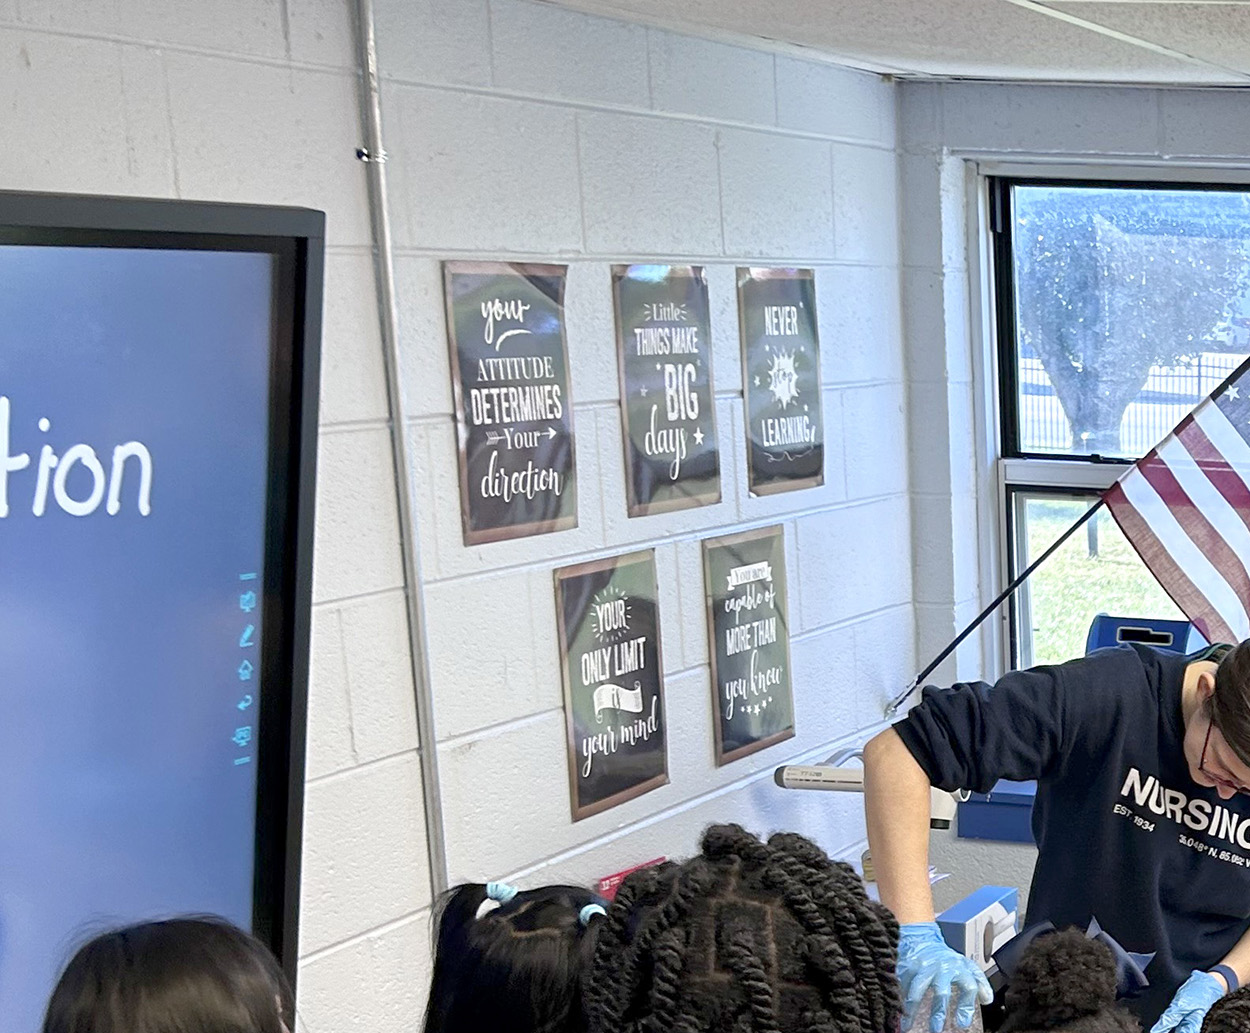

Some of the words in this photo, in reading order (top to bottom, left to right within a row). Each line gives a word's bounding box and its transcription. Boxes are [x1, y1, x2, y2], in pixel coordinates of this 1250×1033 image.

[481, 299, 530, 344] your
[653, 303, 681, 322] Little
[765, 305, 798, 336] NEVER
[634, 328, 670, 356] THINGS
[671, 326, 698, 354] MAKE
[476, 356, 554, 382] ATTITUDE
[470, 384, 562, 426] DETERMINES
[664, 363, 698, 422] BIG
[503, 427, 541, 450] Your
[644, 404, 687, 480] days
[762, 415, 812, 447] LEARNING
[481, 451, 562, 502] direction
[595, 599, 626, 633] YOUR
[725, 583, 763, 625] capable
[764, 583, 776, 609] of
[726, 621, 751, 656] MORE
[752, 617, 776, 649] THAN
[581, 647, 612, 686] ONLY
[614, 637, 646, 676] LIMIT
[725, 677, 748, 720] you
[750, 650, 784, 696] know
[582, 726, 618, 777] your
[620, 695, 658, 745] mind
[1133, 815, 1156, 832] 1934
